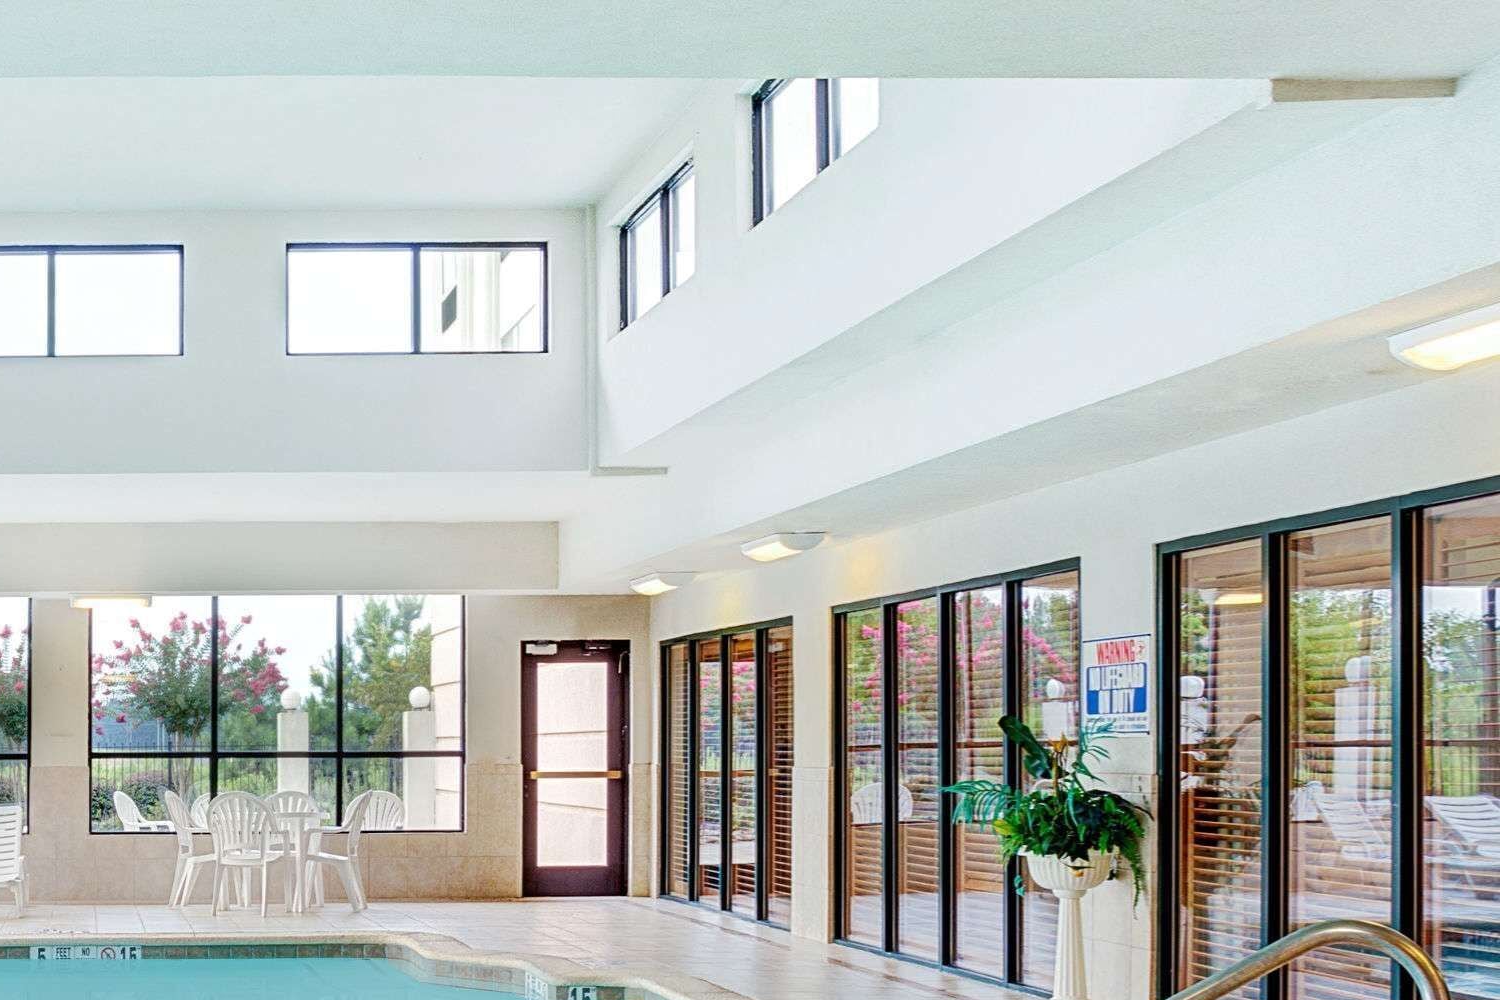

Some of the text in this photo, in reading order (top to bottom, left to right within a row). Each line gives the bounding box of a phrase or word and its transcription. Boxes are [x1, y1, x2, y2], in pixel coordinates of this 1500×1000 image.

[1096, 640, 1135, 664] WARNING
[56, 947, 71, 957] FEET
[82, 947, 90, 956] NO
